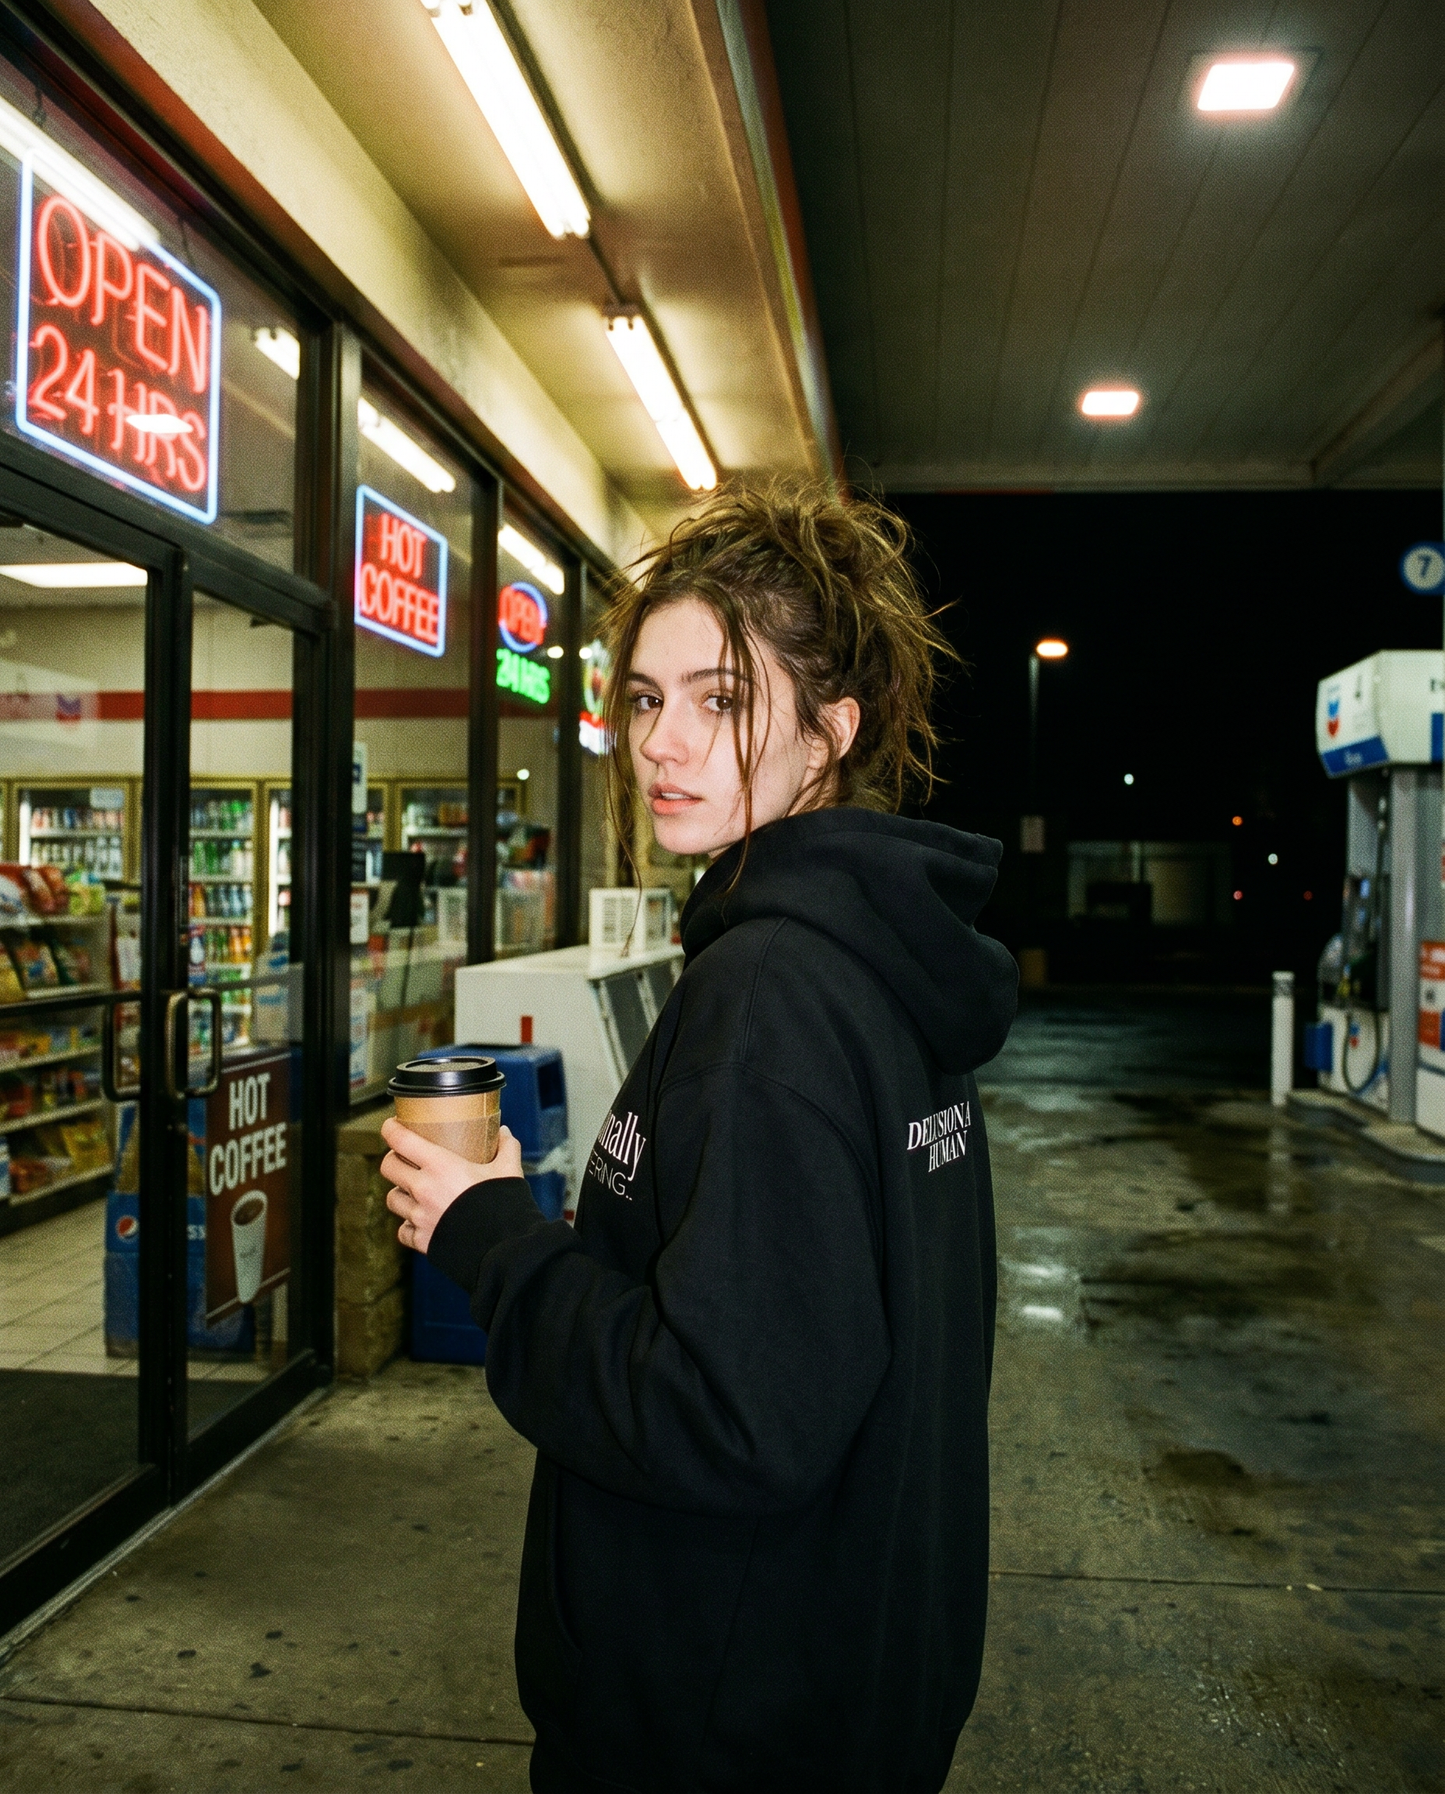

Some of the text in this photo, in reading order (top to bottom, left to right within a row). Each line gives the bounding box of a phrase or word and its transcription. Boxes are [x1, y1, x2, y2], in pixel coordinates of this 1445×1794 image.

[37, 195, 210, 393] OPEN
[378, 511, 428, 580] HOT
[1417, 553, 1433, 579] 7
[360, 561, 441, 646] COFFEE
[497, 585, 547, 646] OPEN
[228, 1072, 272, 1132] HOT
[209, 1121, 288, 1197] COFFEE
[928, 1130, 968, 1173] HUMAN
